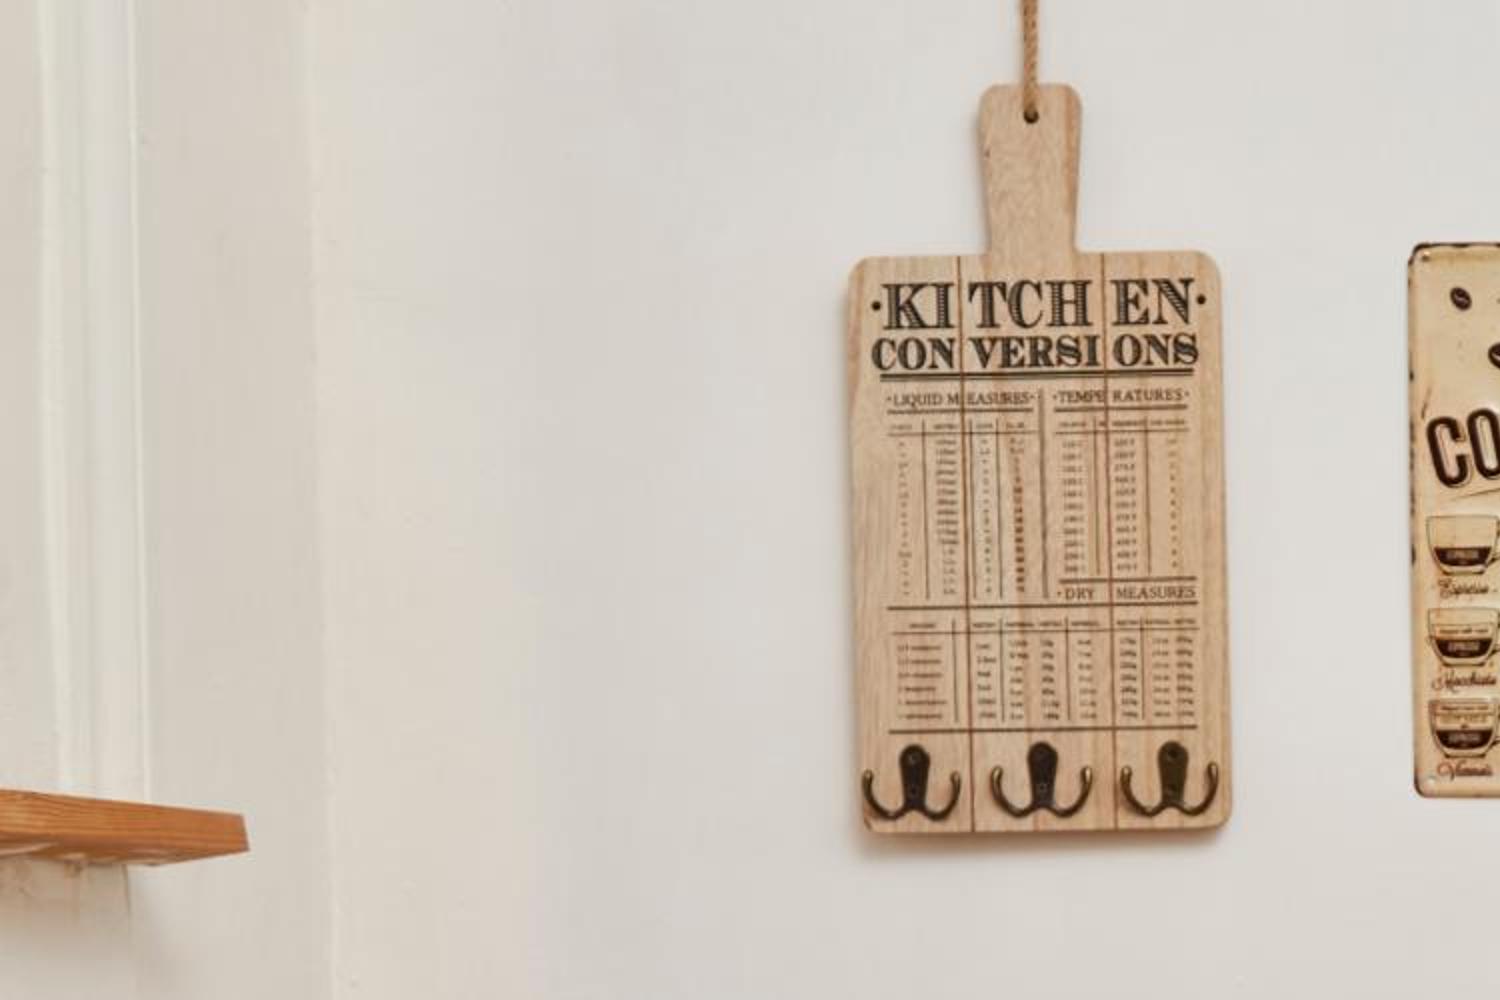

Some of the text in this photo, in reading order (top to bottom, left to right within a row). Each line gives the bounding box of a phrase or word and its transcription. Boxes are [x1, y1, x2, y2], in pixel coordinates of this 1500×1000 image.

[882, 277, 1195, 330] KITCHEN
[871, 332, 1199, 371] CONVERSIONS
[894, 391, 1029, 408] LIQUID MEASURES
[1064, 586, 1195, 601] DRY MEASURES
